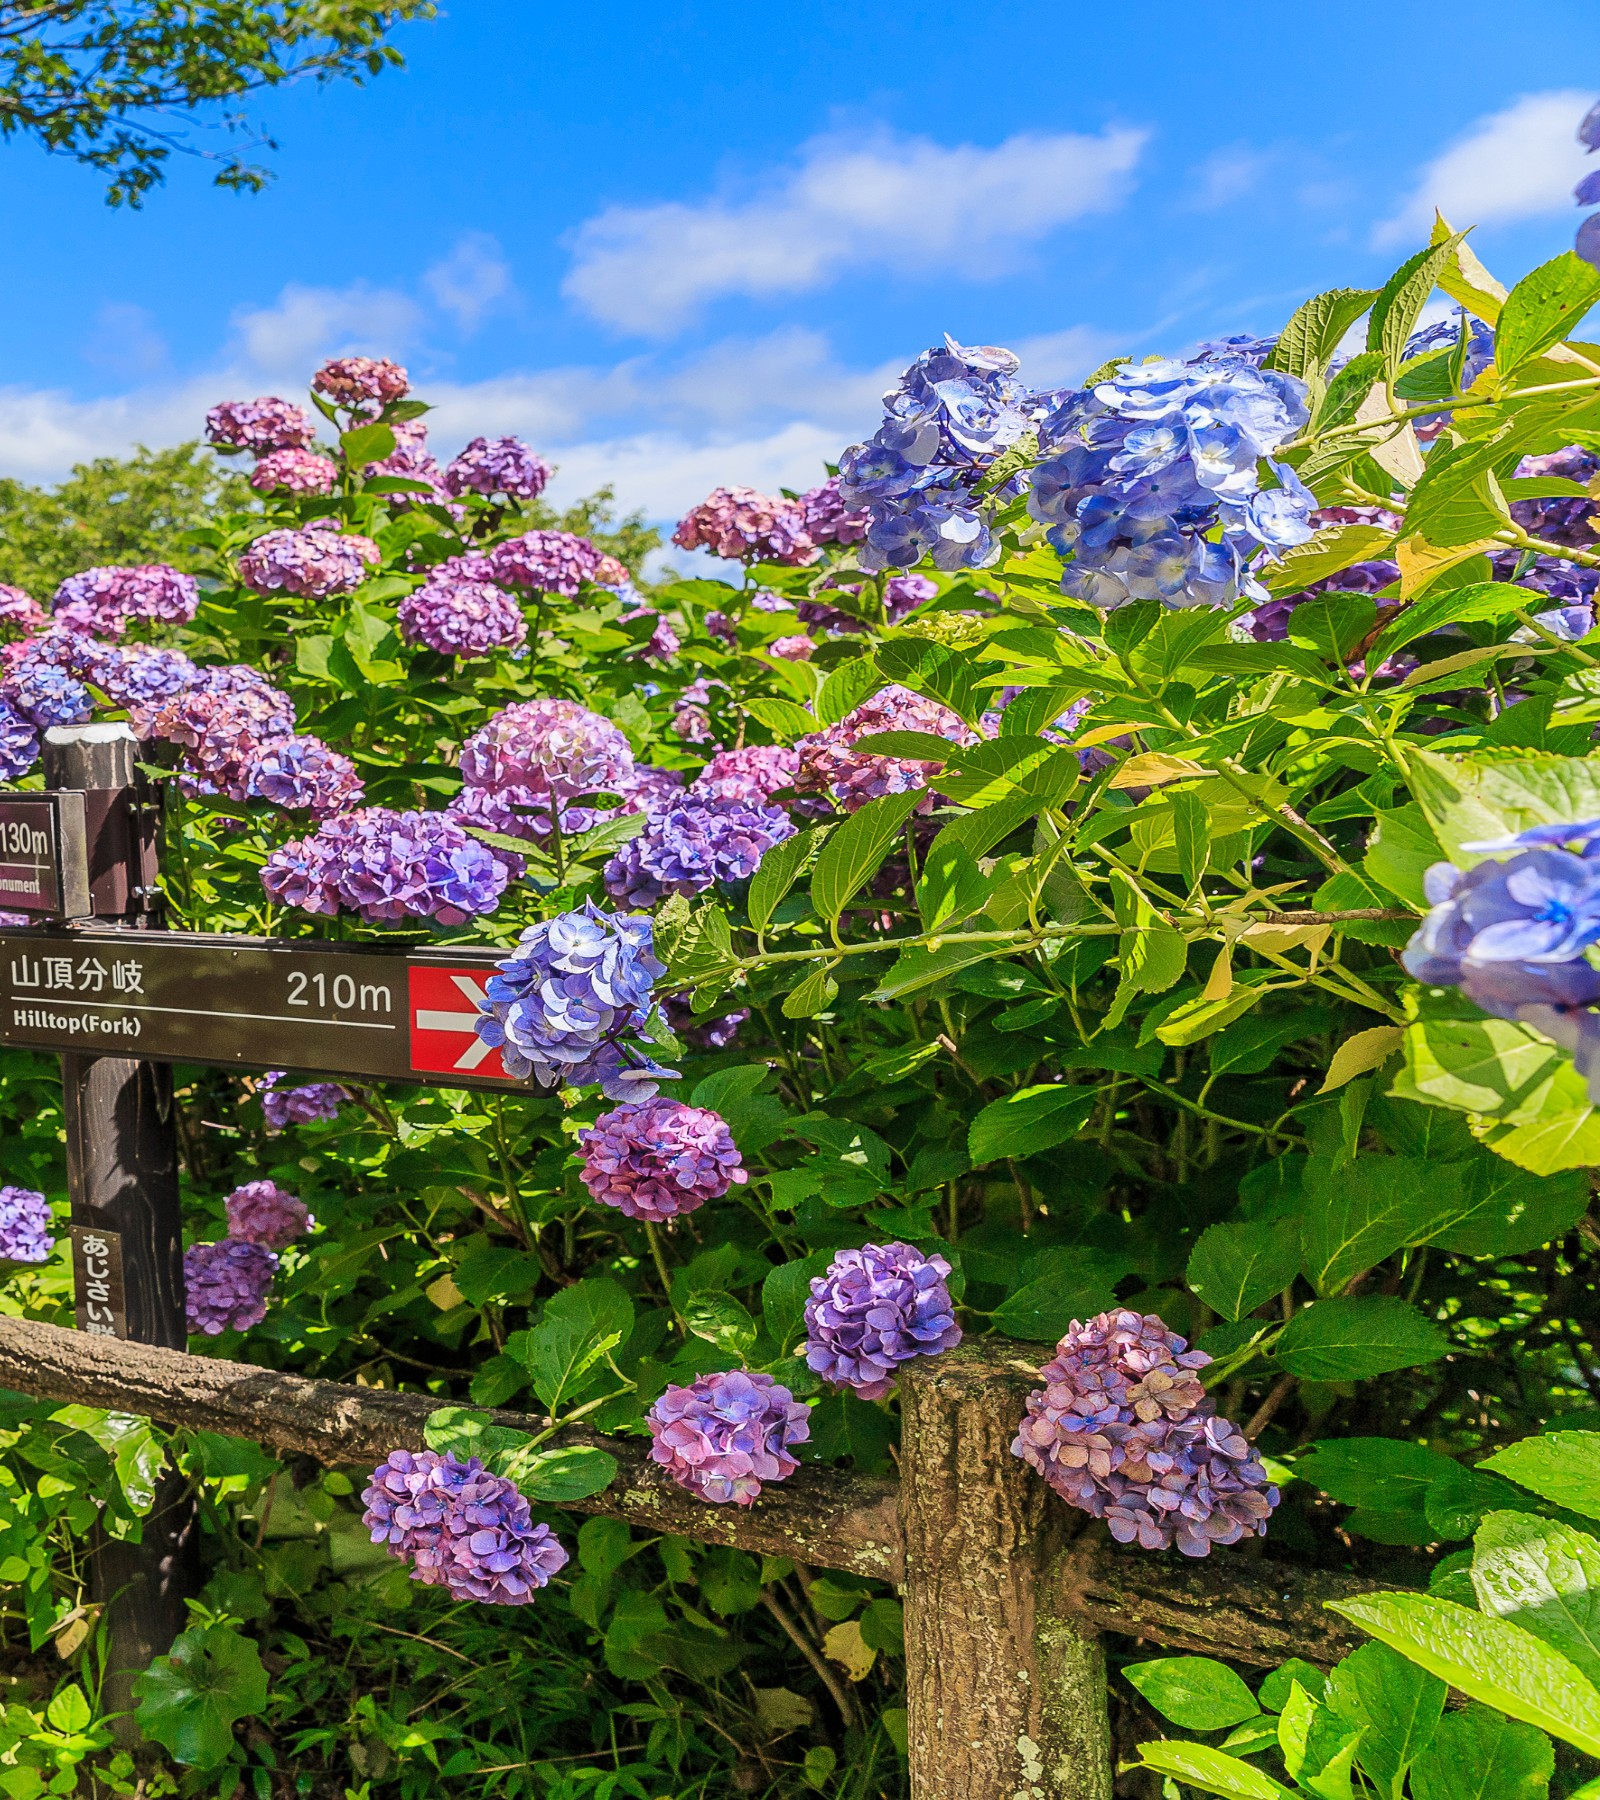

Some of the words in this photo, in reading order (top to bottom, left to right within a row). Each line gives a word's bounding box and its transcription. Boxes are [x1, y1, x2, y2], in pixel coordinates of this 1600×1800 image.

[11, 954, 145, 994] 山頂分岐
[287, 971, 392, 1013] 210m
[13, 1009, 141, 1037] Hilltop(Fork)
